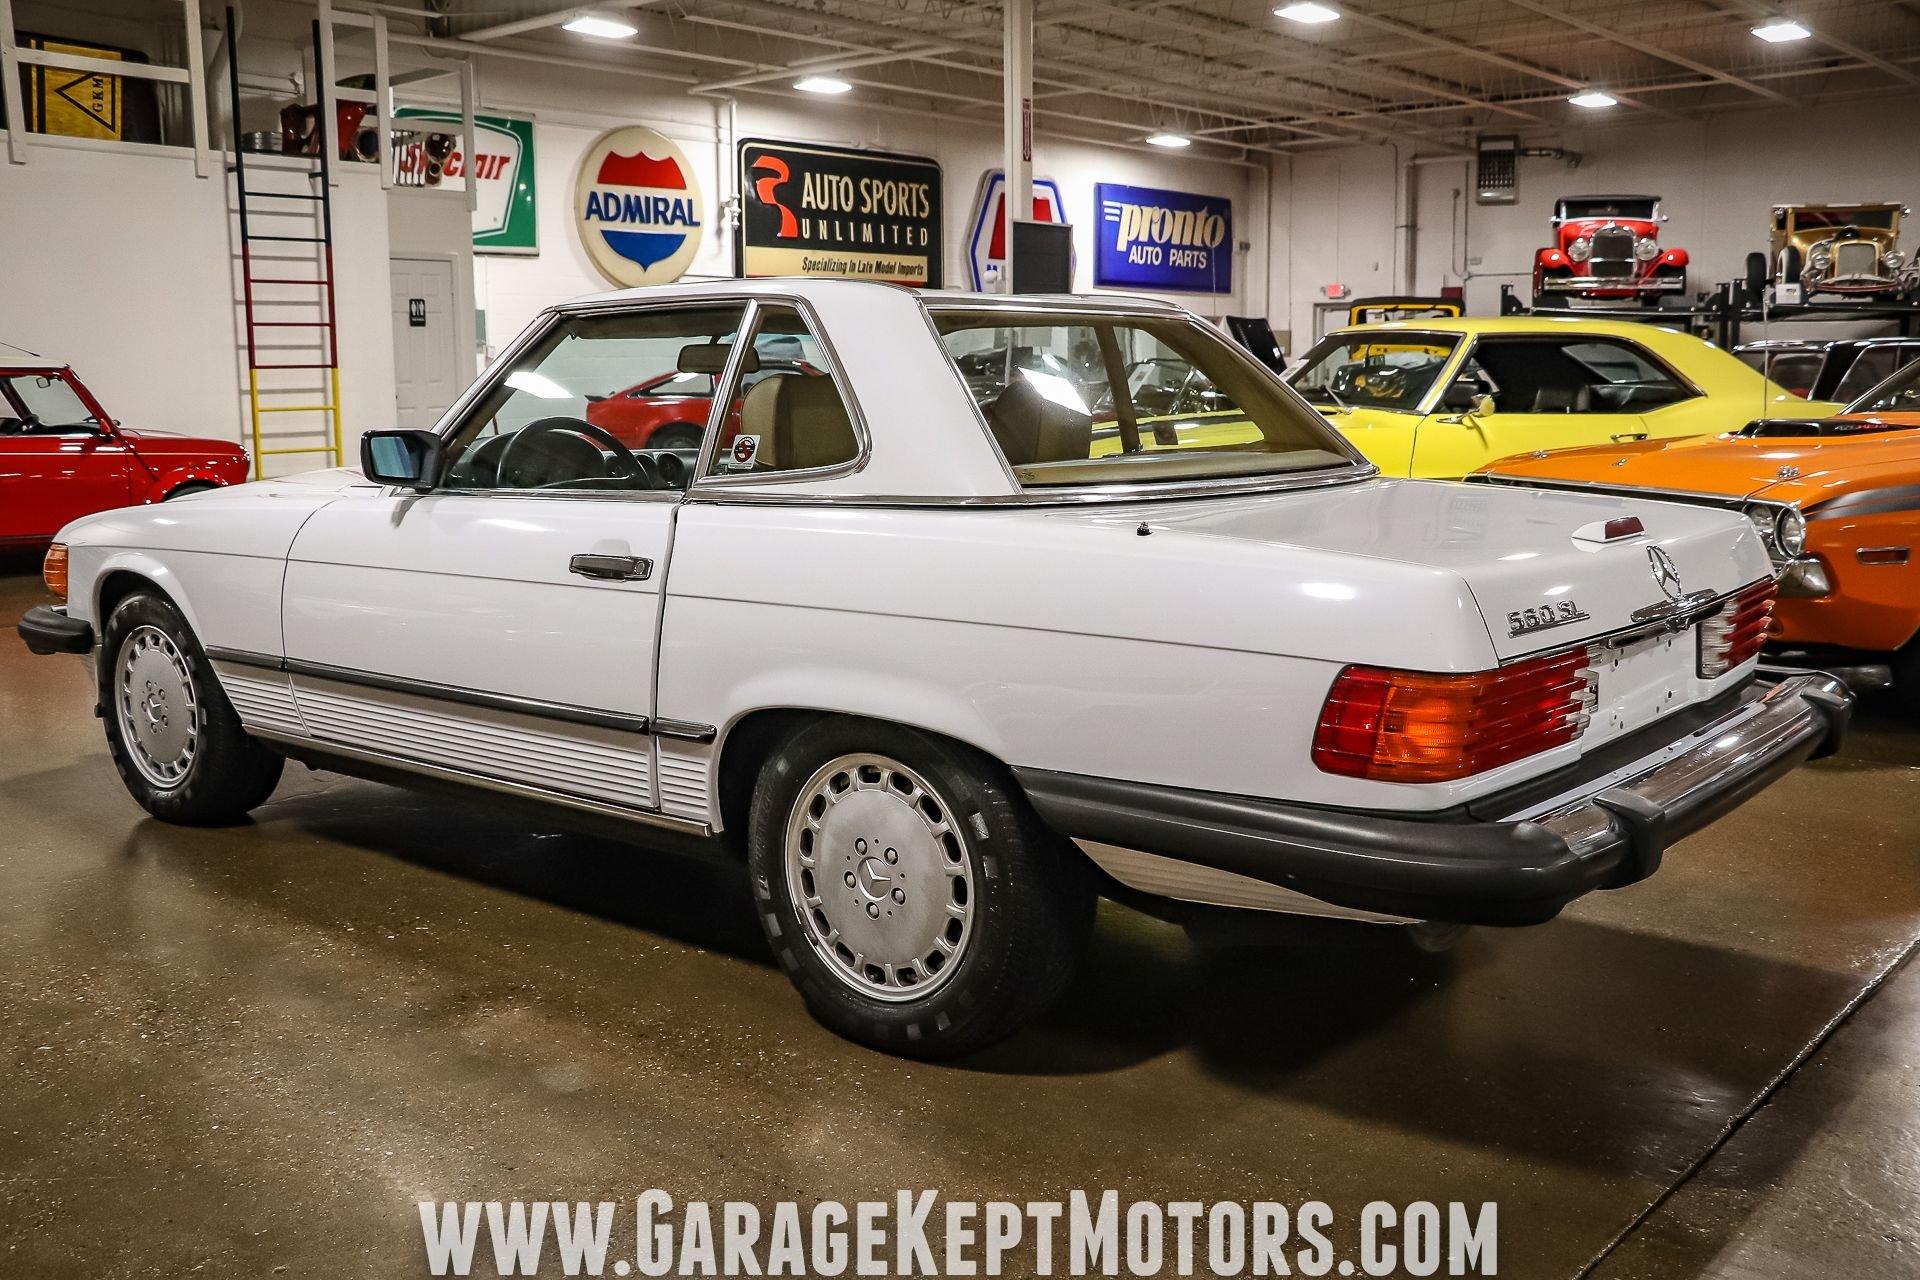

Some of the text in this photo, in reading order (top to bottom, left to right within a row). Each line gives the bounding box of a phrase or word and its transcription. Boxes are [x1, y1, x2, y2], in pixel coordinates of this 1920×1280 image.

[92, 77, 104, 113] GKM
[584, 191, 701, 227] ADMIRAL
[801, 172, 930, 219] AUTO SPORTS
[801, 218, 929, 247] UNLIMITED
[1116, 203, 1226, 252] pronto
[802, 256, 848, 275] Specializing
[857, 260, 875, 274] Late
[874, 260, 897, 275] Model
[897, 262, 925, 277] Imports
[1128, 244, 1207, 269] AUTO PARTS
[1506, 600, 1586, 632] 560 SL
